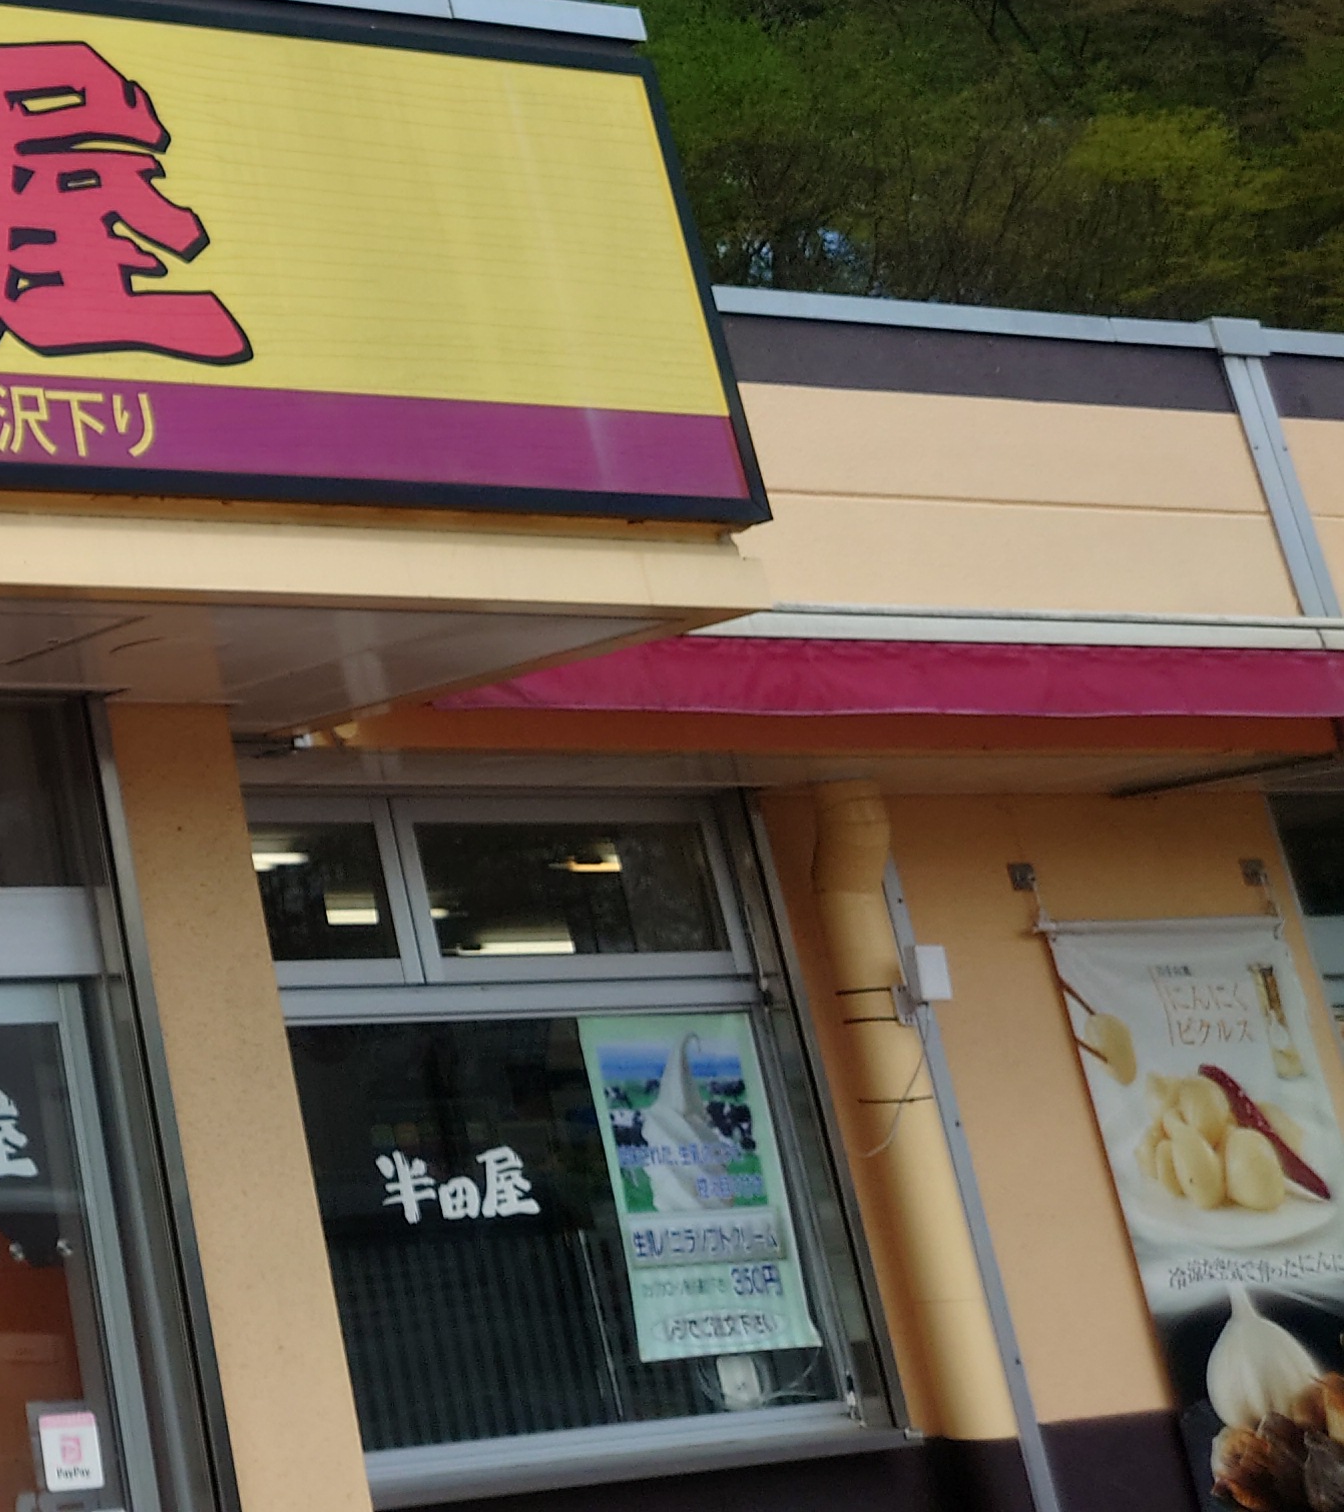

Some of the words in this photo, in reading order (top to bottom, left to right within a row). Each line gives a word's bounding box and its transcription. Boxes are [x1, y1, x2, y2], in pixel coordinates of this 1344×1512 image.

[1165, 982, 1249, 1011] にんにく
[375, 1145, 541, 1224] 半田屋
